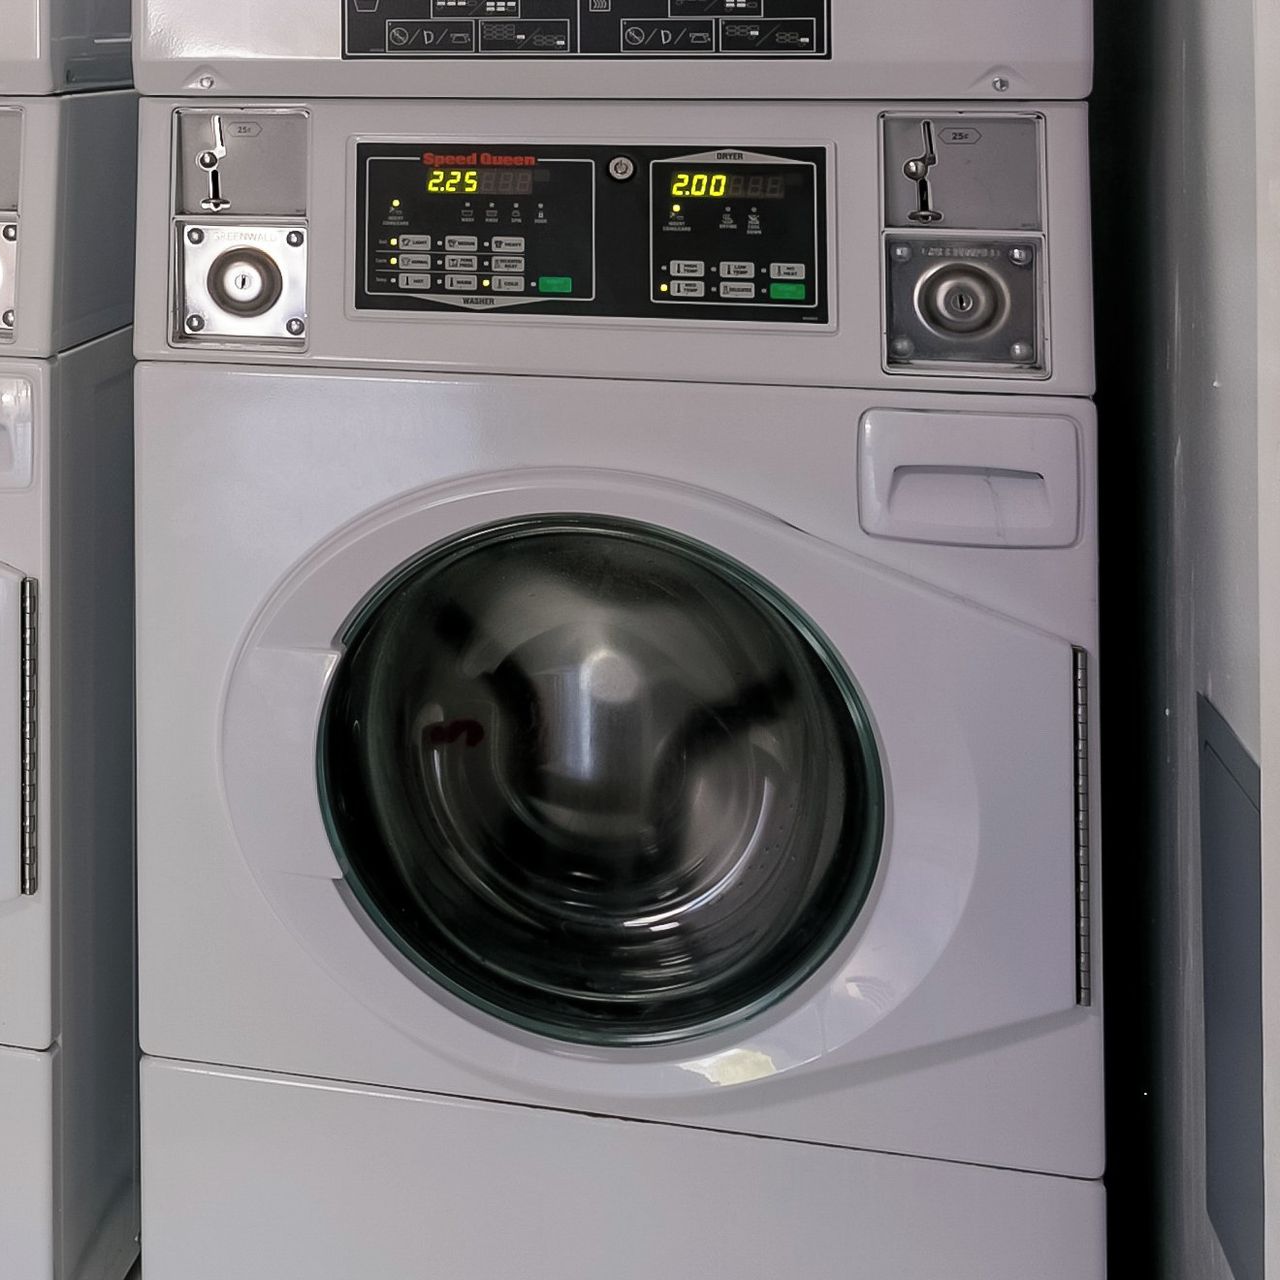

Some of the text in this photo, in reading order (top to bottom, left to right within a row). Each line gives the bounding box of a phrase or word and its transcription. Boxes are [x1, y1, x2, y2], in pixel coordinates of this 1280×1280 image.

[422, 152, 536, 167] Speed Queen
[716, 152, 744, 160] DRYER
[427, 171, 478, 192] 2.25
[672, 174, 727, 196] 2.00
[462, 297, 495, 305] WASHER
